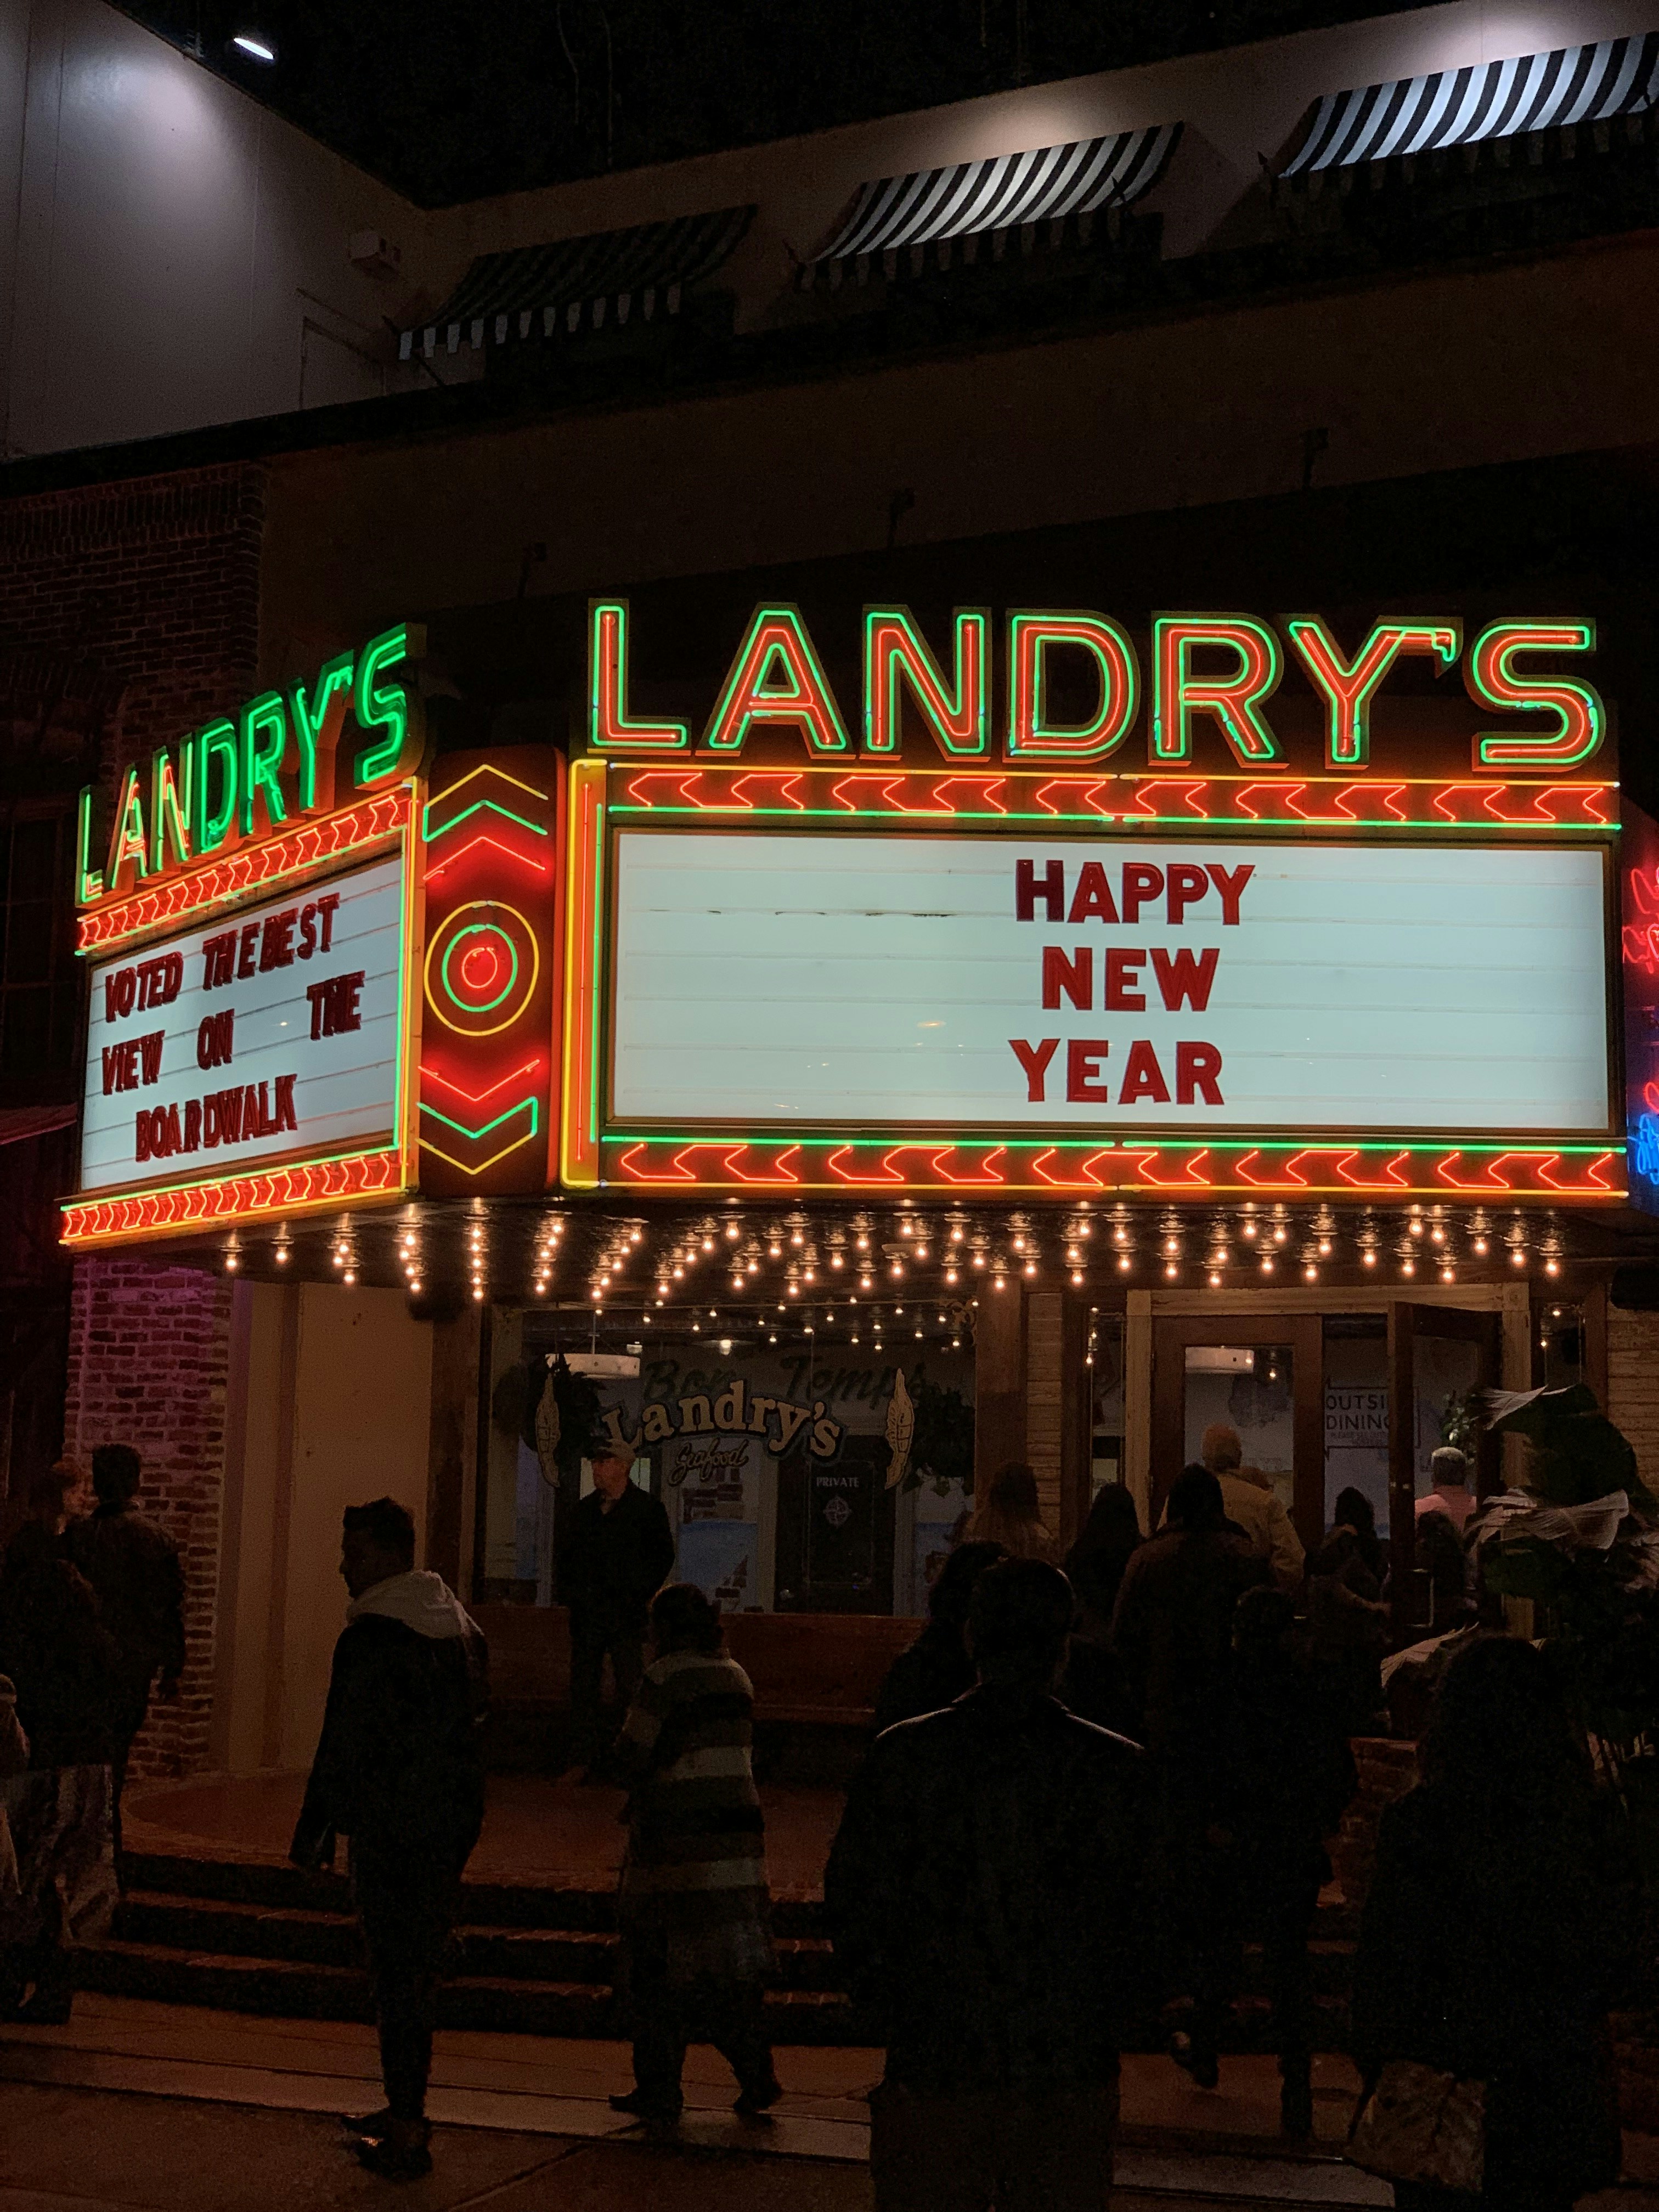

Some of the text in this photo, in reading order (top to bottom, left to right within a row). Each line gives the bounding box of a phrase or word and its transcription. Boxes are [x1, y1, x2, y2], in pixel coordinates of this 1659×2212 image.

[588, 598, 1605, 769] LANDRY'S
[75, 622, 409, 906] LANDRY'S
[1015, 859, 1256, 926] HAPPY
[105, 951, 183, 1022] VOTED
[1042, 946, 1220, 1012] NEW
[102, 970, 365, 1096] VIEW ON THE
[1008, 1038, 1224, 1105] YEAR
[136, 1073, 297, 1163] BOARDWALK
[601, 1379, 842, 1460] Landry's
[1325, 1395, 1386, 1410] OUTSI
[668, 1437, 749, 1486] Seafood
[816, 1476, 860, 1488] PRIVATE
